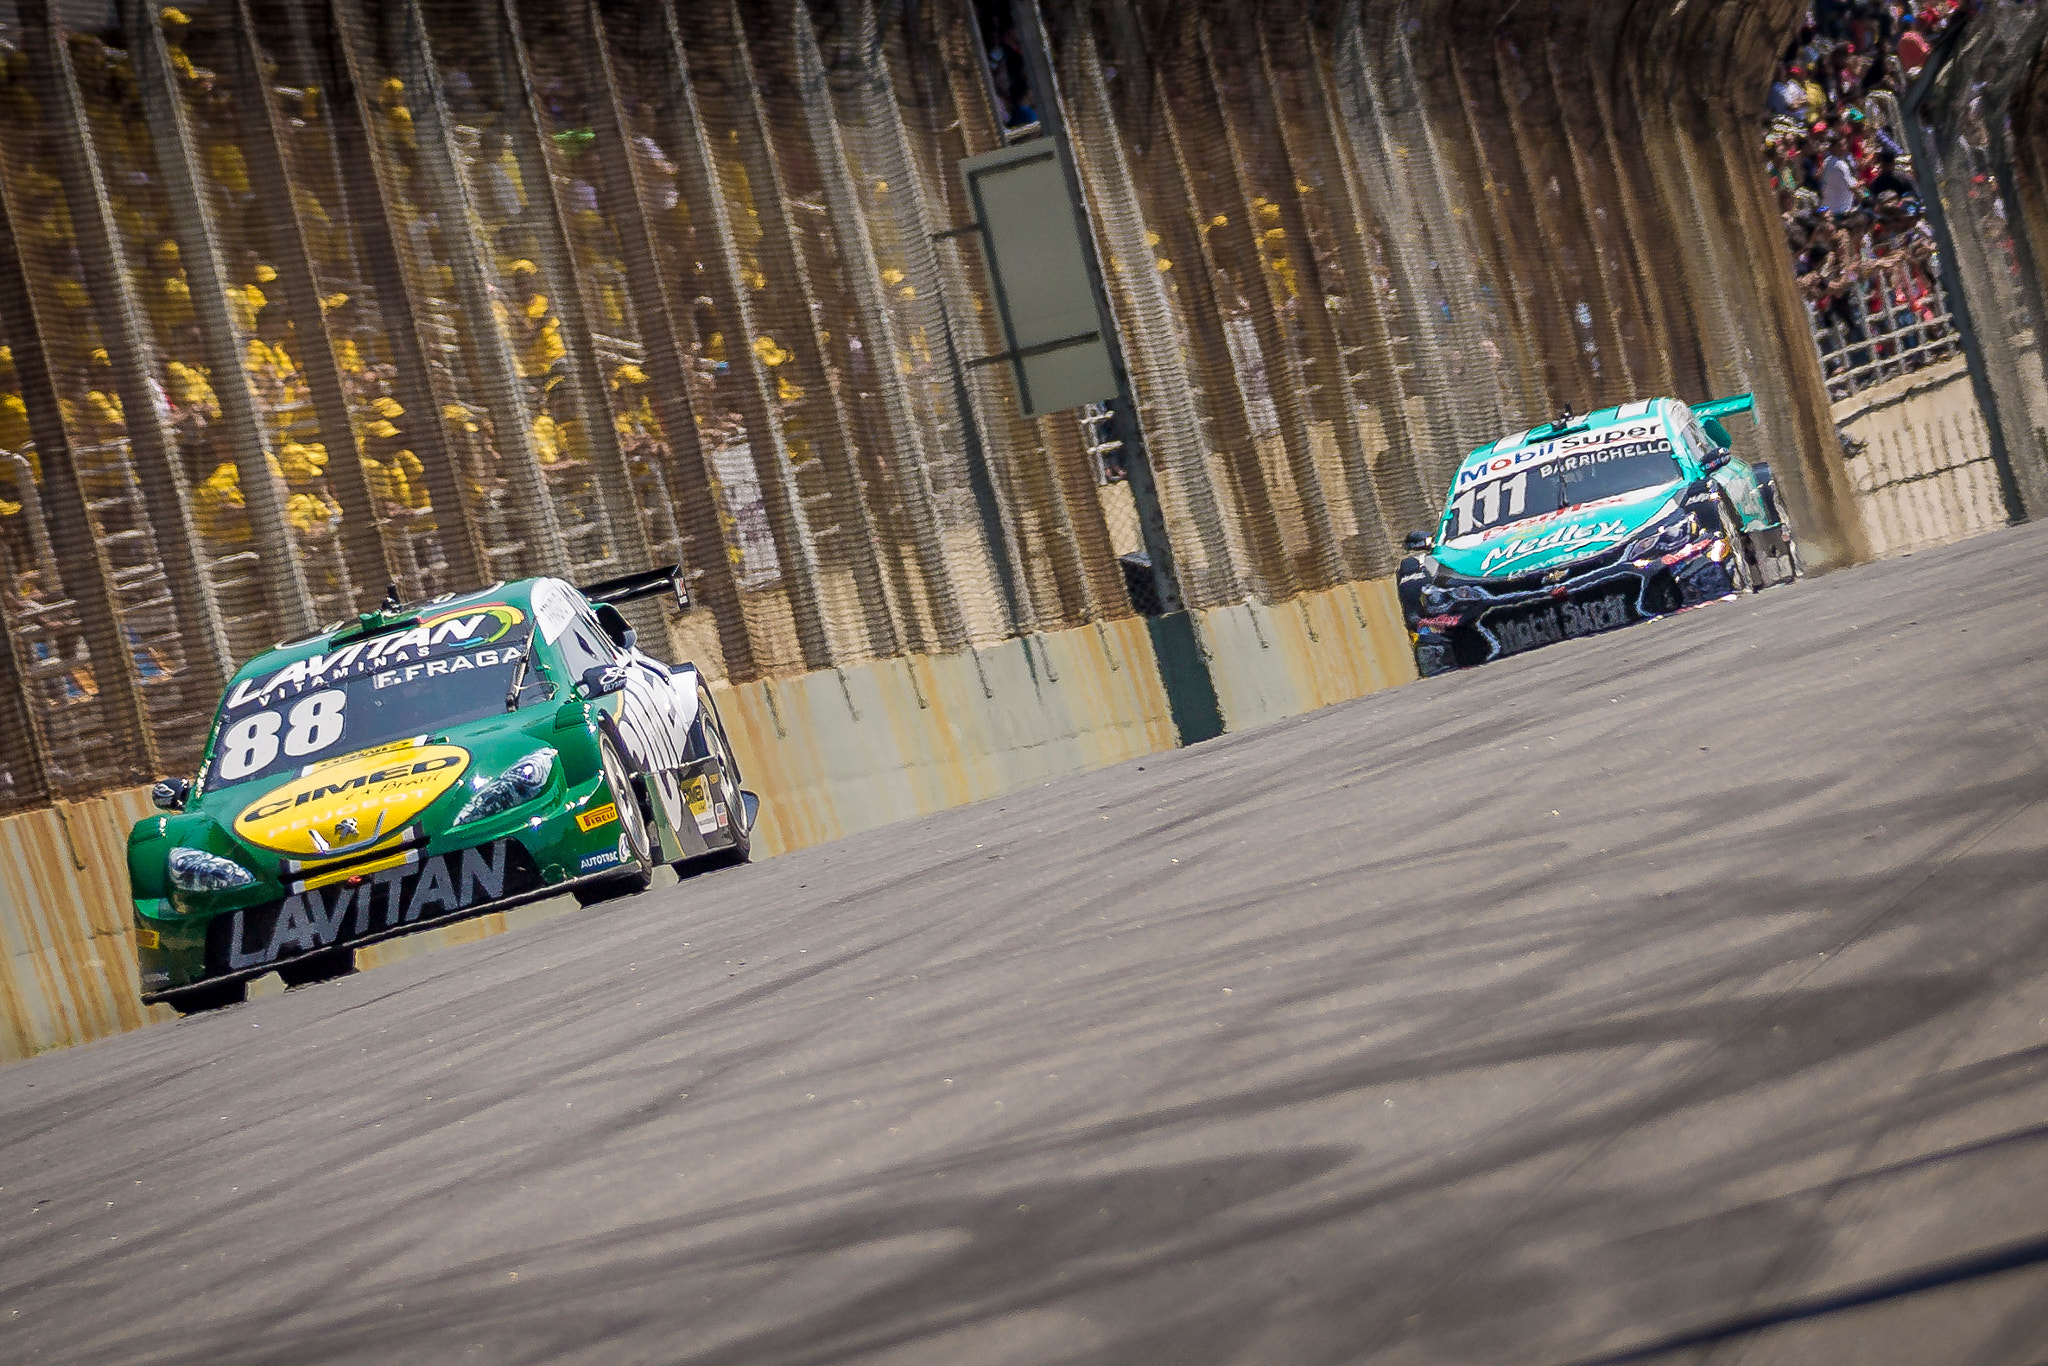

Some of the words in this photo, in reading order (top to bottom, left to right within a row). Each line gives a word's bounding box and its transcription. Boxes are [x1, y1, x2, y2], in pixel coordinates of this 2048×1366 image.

[1460, 442, 1554, 485] Mobil
[1559, 423, 1661, 449] Super
[1539, 440, 1672, 478] BARRICHELLO
[1451, 471, 1528, 535] 111
[227, 614, 487, 710] LAVITAN
[258, 646, 431, 707] VITAMINAS
[219, 689, 347, 781] 88
[244, 755, 462, 823] CIMED
[268, 787, 430, 839] PEUGEOT
[229, 842, 508, 970] LAVITAN
